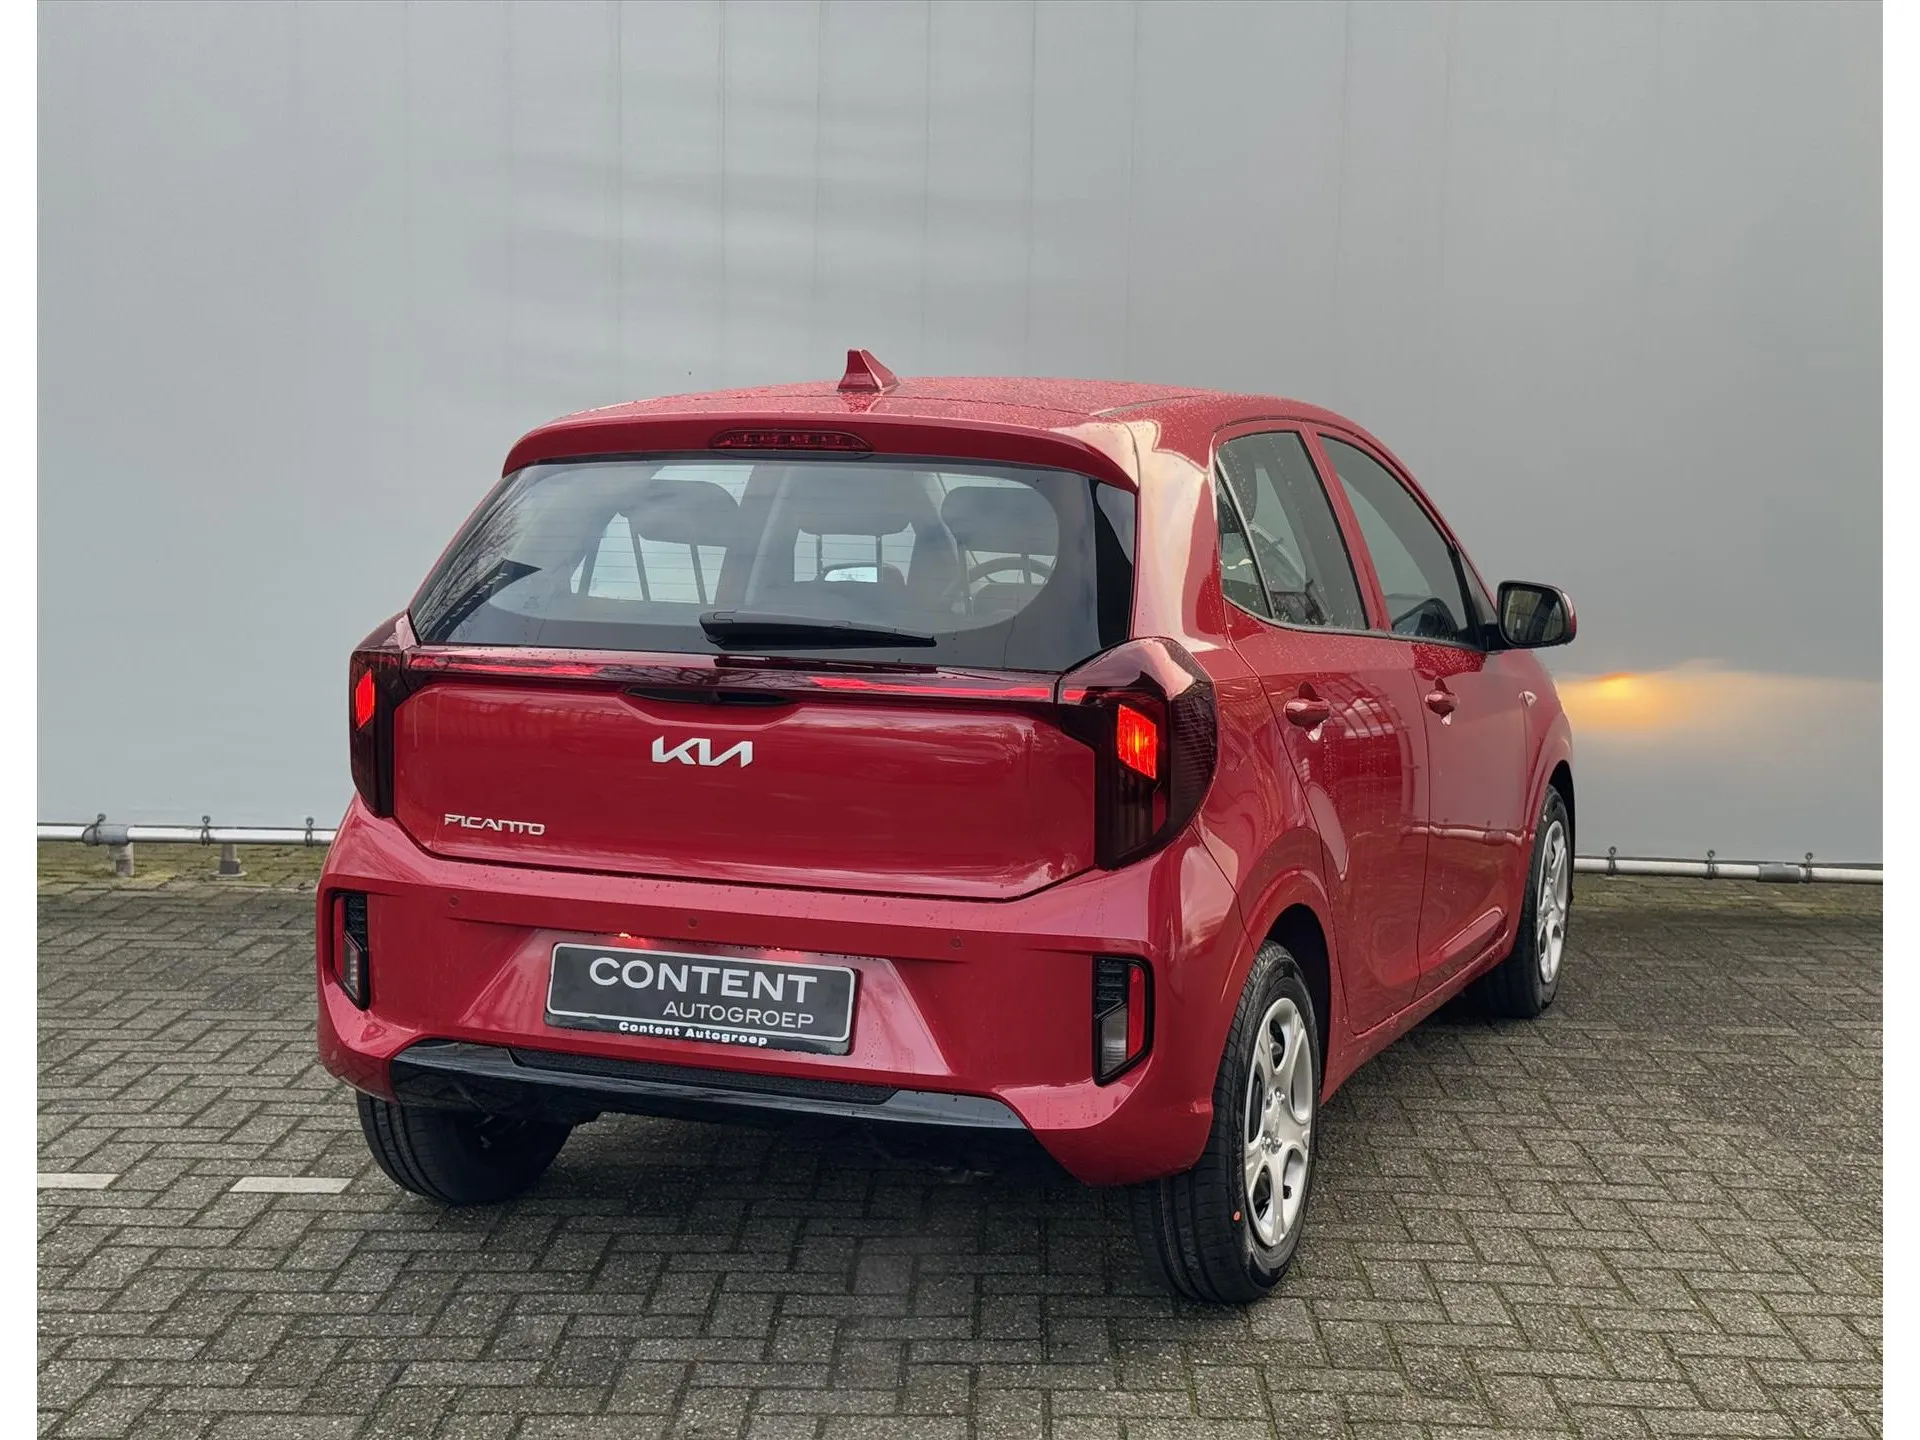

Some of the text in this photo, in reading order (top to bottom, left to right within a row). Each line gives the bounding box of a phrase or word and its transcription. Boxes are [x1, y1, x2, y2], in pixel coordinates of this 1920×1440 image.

[652, 735, 753, 768] KIA
[444, 813, 545, 836] PICANTO
[589, 957, 817, 1003] CONTENT
[662, 1001, 814, 1028] AUTOGROEP
[618, 1021, 768, 1046] Content Autogroep
